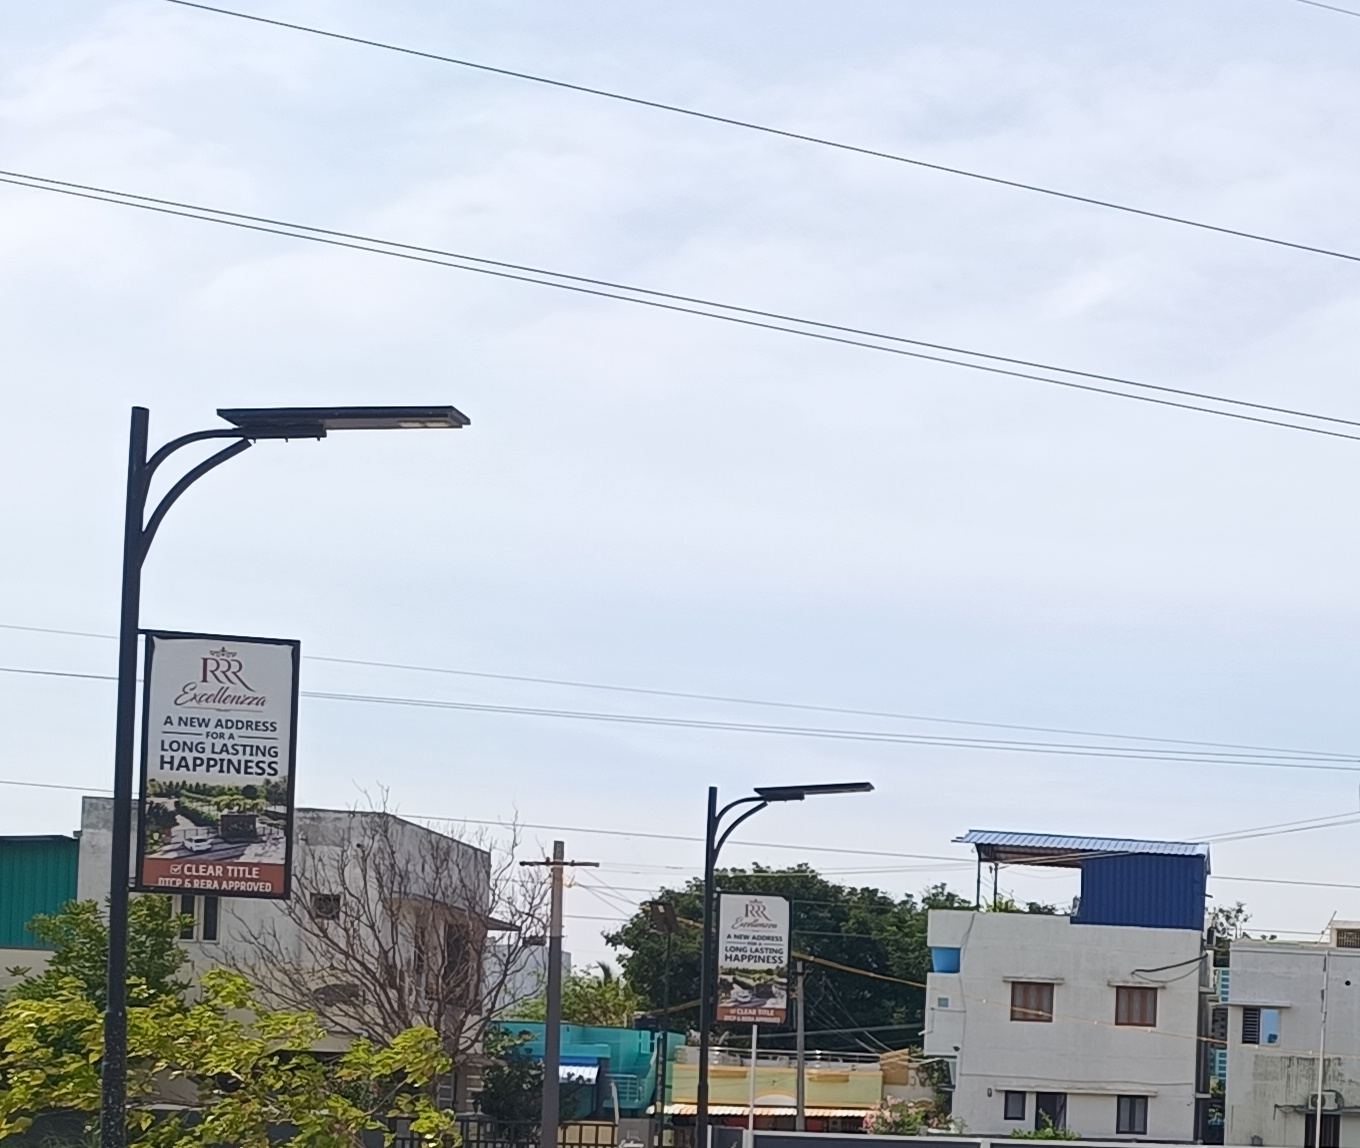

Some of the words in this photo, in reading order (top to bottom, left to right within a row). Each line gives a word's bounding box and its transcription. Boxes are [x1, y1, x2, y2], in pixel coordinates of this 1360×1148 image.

[201, 657, 256, 692] RRR
[164, 715, 173, 726] A
[178, 716, 211, 728] NEW
[214, 718, 277, 732] ADDRESS
[206, 731, 225, 740] FOR
[160, 739, 206, 754] LONG
[211, 742, 279, 758] LASTING
[160, 754, 279, 777] HAPPINESS
[184, 863, 223, 877] CLEAR
[227, 865, 260, 879] TITLE
[193, 879, 220, 890] RERA
[221, 881, 272, 893] APPROVED
[745, 904, 772, 922] RRR
[725, 946, 748, 954] LONG
[750, 947, 784, 955] LASTING
[725, 954, 784, 965] HAPPINESS
